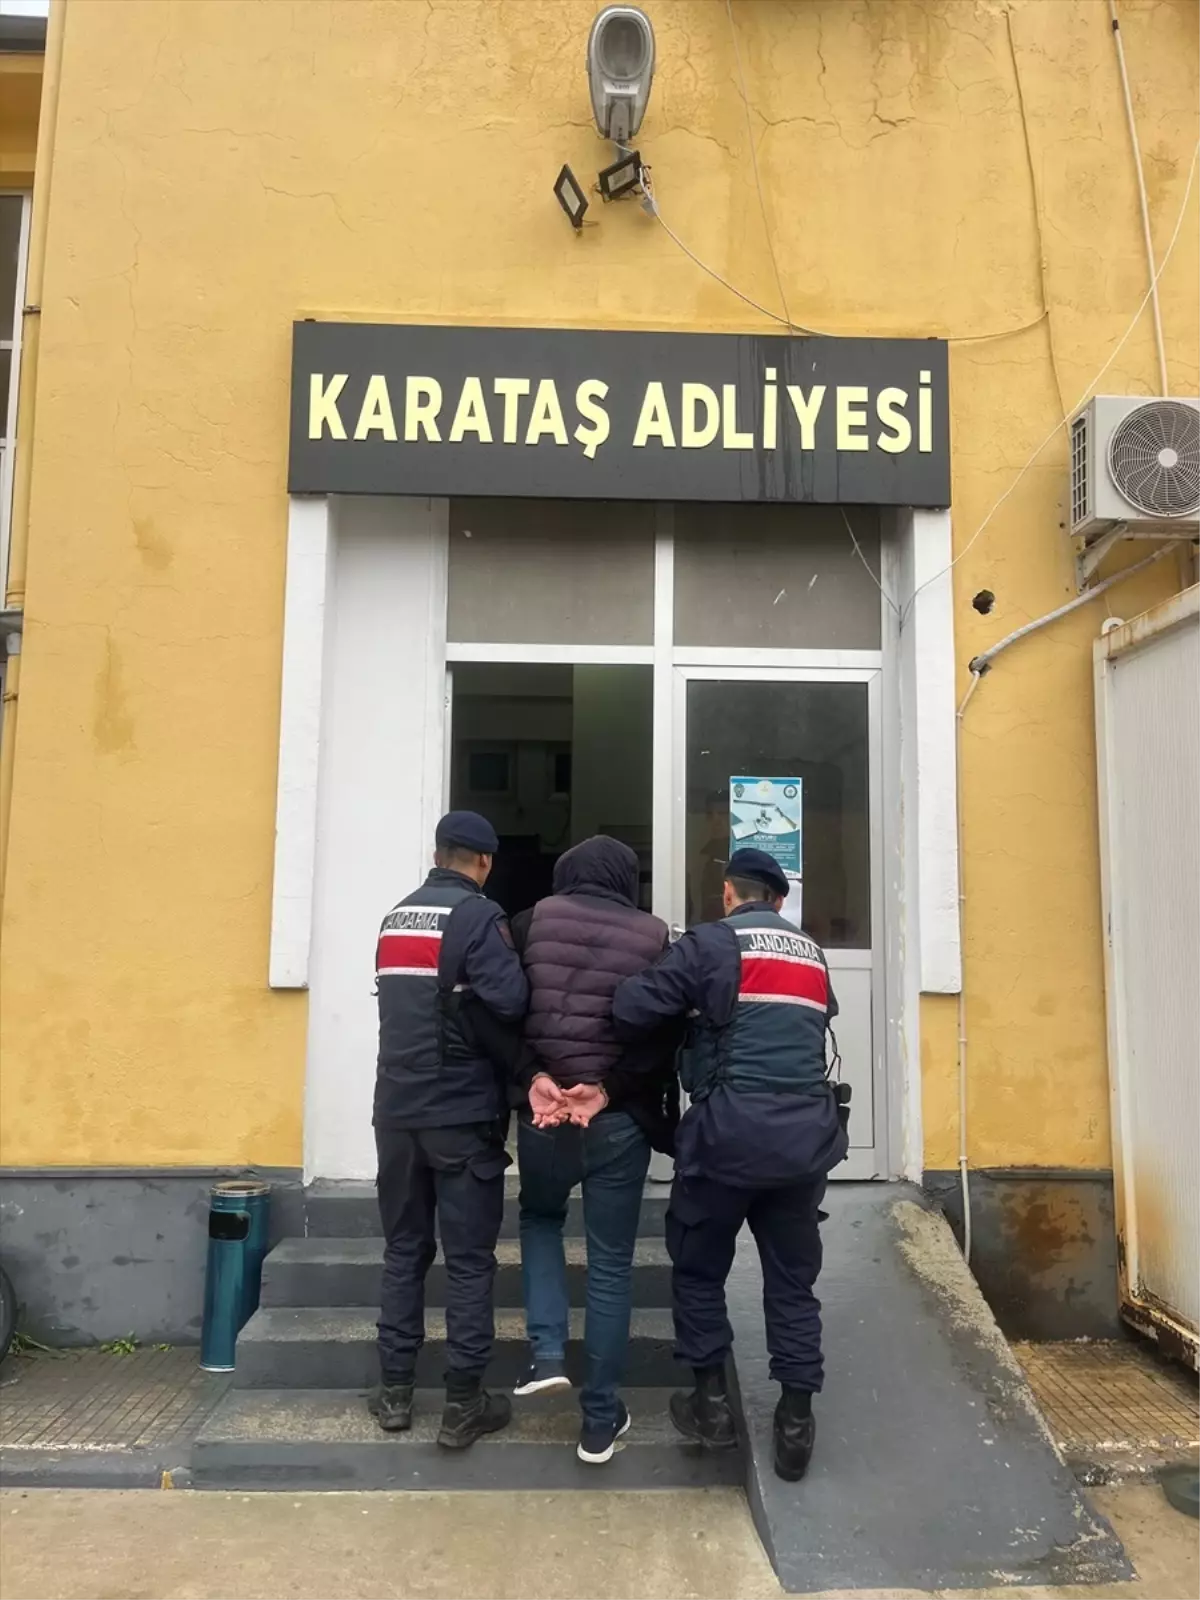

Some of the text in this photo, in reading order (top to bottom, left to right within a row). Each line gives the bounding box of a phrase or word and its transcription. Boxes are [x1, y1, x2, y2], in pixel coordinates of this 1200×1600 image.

[308, 366, 933, 459] KARATAŞ ADLİYESİ
[384, 912, 439, 930] ANDARMA
[749, 934, 820, 960] JANDARMA
